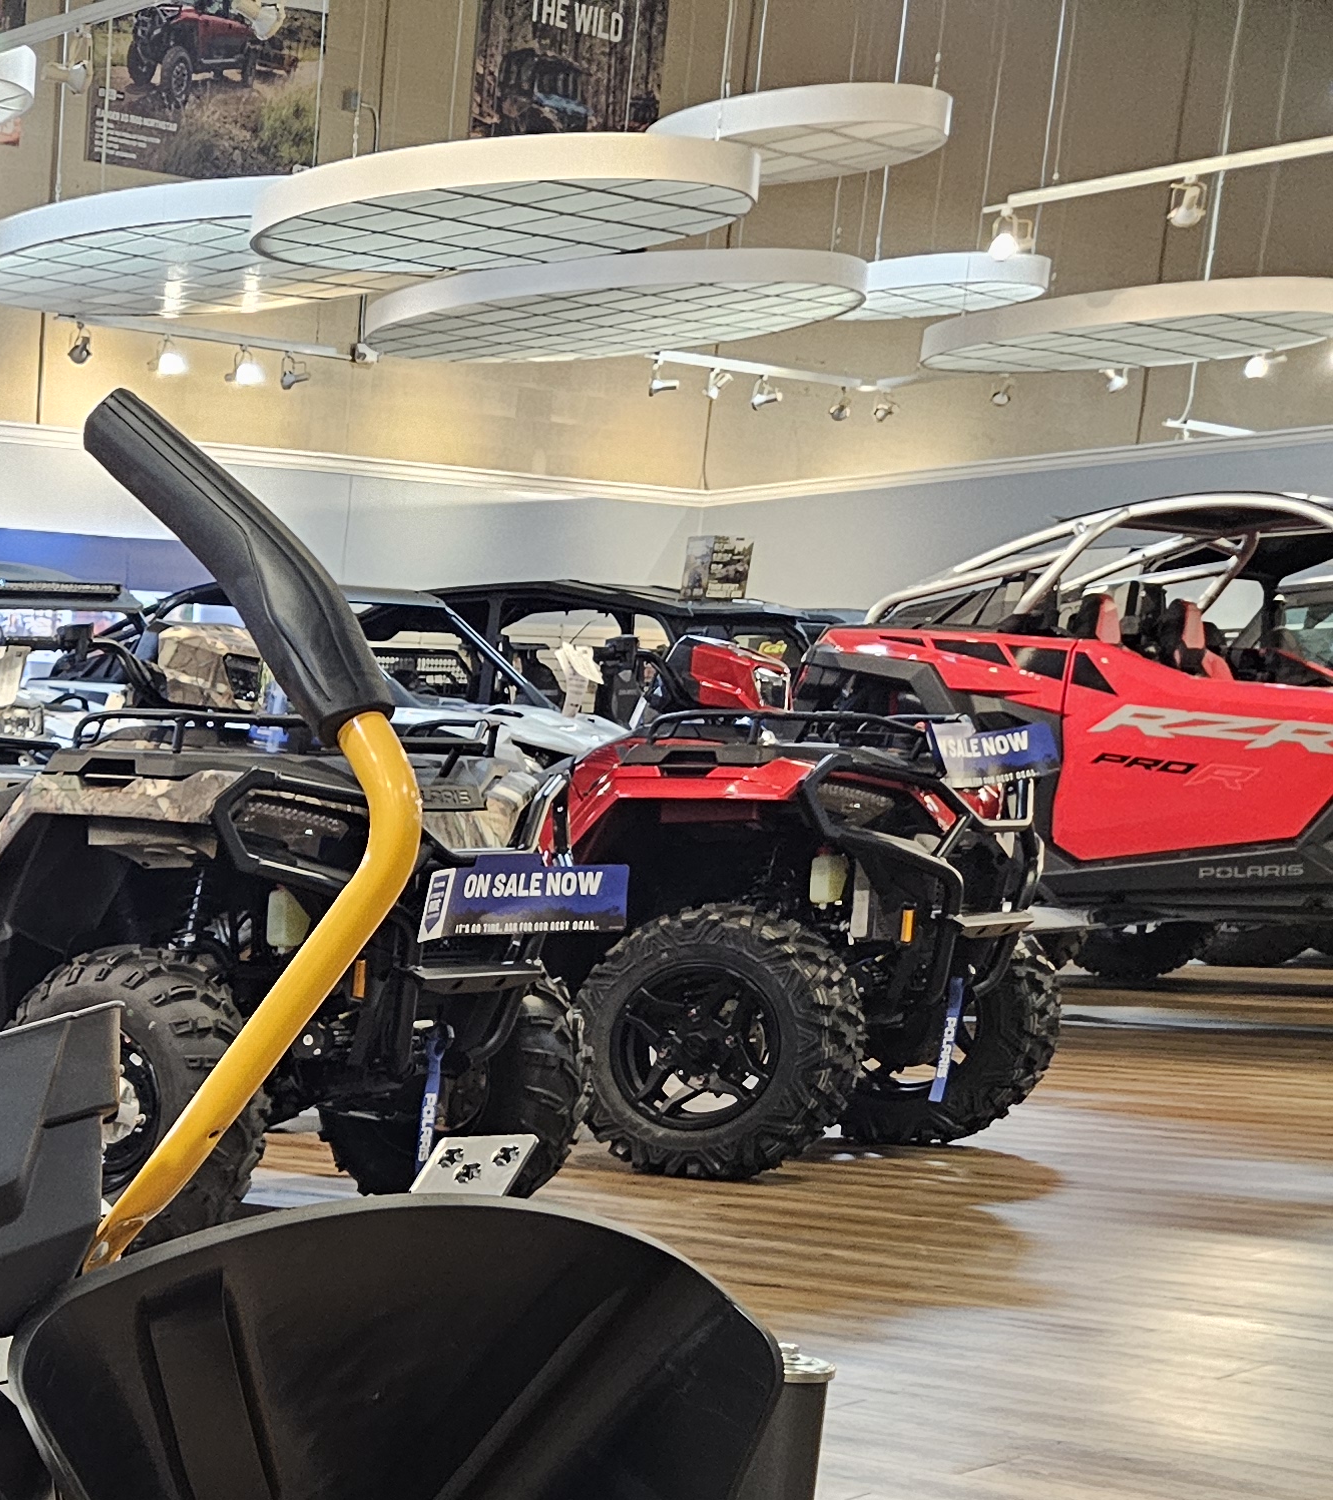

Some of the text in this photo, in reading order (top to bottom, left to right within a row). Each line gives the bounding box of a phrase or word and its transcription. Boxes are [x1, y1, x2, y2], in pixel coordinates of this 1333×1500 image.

[532, 0, 623, 42] THE WILD
[981, 730, 1028, 756] NOW
[1087, 703, 1333, 756] RZR
[1091, 752, 1261, 791] PRO R
[463, 871, 603, 898] ON SALE NOW
[1198, 863, 1304, 879] POLARIS
